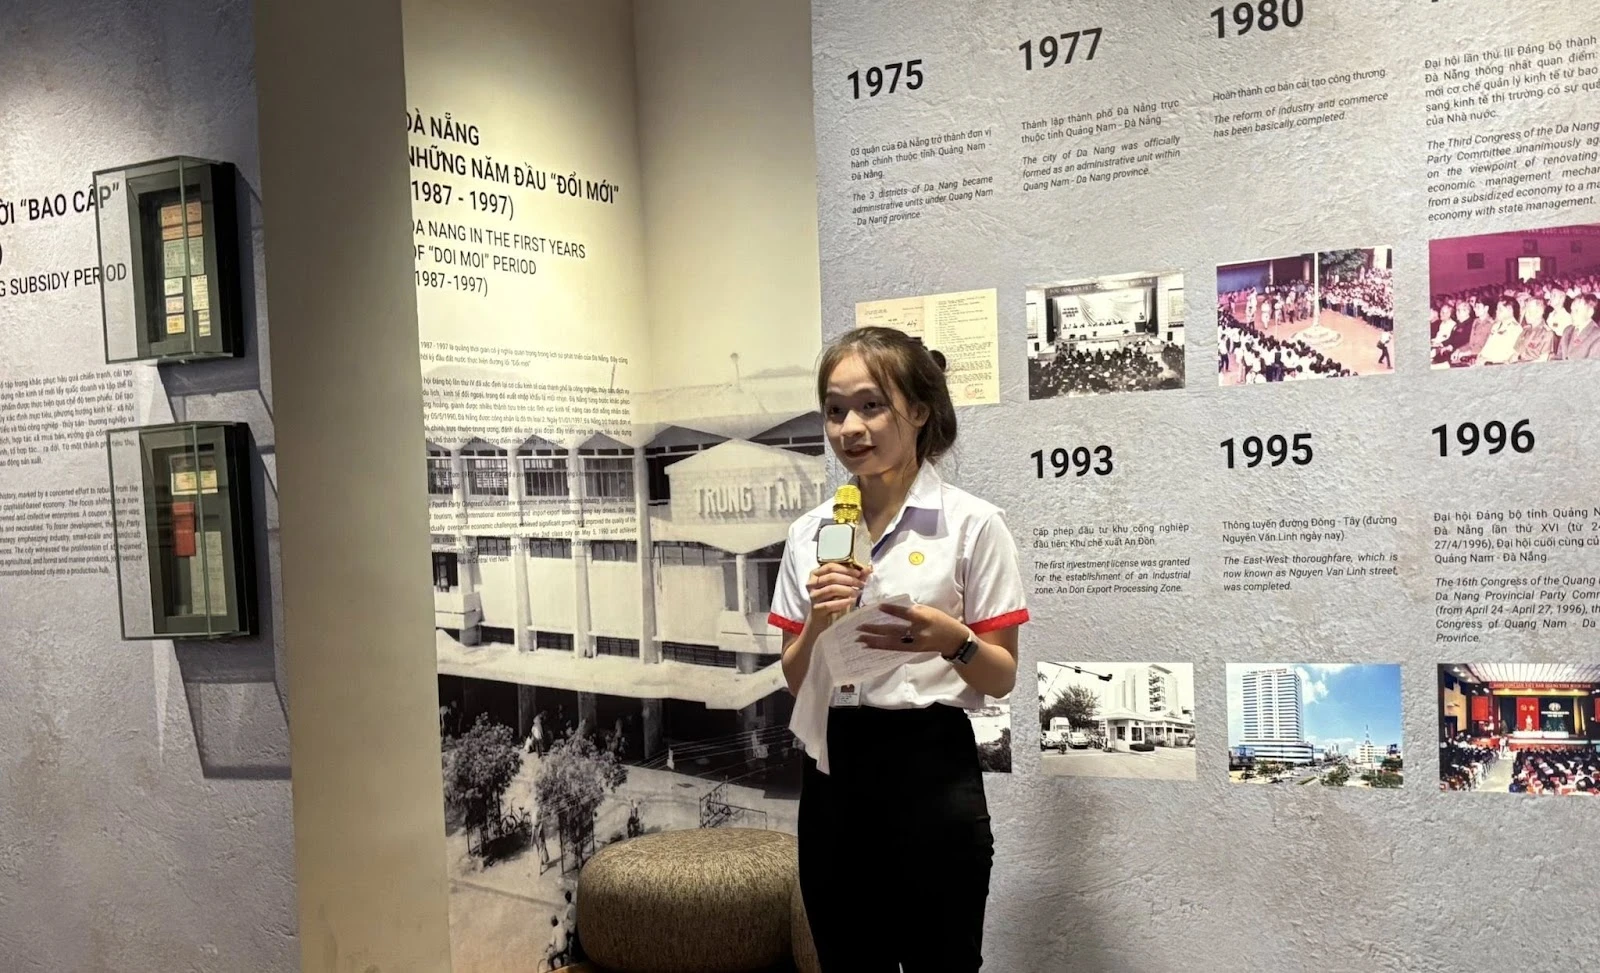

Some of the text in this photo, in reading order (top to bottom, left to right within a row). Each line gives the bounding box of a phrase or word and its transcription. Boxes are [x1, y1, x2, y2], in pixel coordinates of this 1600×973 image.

[1210, 0, 1303, 38] 1980
[1019, 28, 1102, 70] 1977
[848, 59, 923, 99] 1975
[1214, 93, 1388, 124] The reform of industry and commerce
[430, 112, 479, 146] NẴNG
[1214, 119, 1294, 137] has been basically
[1427, 122, 1599, 150] The Third Congress of the Da Nang
[1023, 135, 1180, 165] The city of Da Nang was officially
[1427, 138, 1581, 164] Party Committee unanimously
[409, 145, 466, 175] NHỮNG
[472, 156, 509, 184] NĂM
[514, 162, 546, 191] ĐẦU
[1023, 167, 1050, 177] formed
[1065, 164, 1074, 172] an
[1077, 154, 1135, 170] administrative
[1137, 154, 1153, 162] unit
[1155, 150, 1180, 159] within
[1447, 166, 1462, 176] the
[1470, 160, 1517, 173] viewpoint
[1525, 157, 1536, 167] of
[1543, 151, 1597, 165] renovating
[879, 188, 907, 198] districts
[912, 185, 920, 194] of
[924, 183, 934, 191] Da
[938, 181, 958, 190] Nang
[963, 176, 993, 186] became
[1023, 167, 1150, 191] Quang Nam Da Nang province.
[1428, 172, 1551, 193] economic management
[412, 181, 514, 221] 1987 1997)
[1428, 183, 1575, 207] from subsidized economy to
[0, 198, 14, 225] ỜI
[1428, 196, 1596, 222] economy with state management.
[412, 219, 585, 259] A NANG IN THE FIRST YEARS
[415, 246, 425, 261] F
[494, 256, 536, 275] PERIOD
[0, 280, 5, 296] G
[11, 271, 70, 294] SUBSIDY
[416, 271, 488, 297] 1987-1997)
[1432, 419, 1535, 456] 1996
[1031, 445, 1113, 479] 1993
[1220, 433, 1313, 469] 1995
[694, 485, 754, 517] TRUNG
[764, 472, 802, 516] TÂM
[1224, 556, 1239, 564] The
[1243, 555, 1288, 564] East-West
[1292, 554, 1353, 565] thoroughfare,
[1358, 553, 1385, 561] which
[1035, 573, 1045, 581] for
[1066, 572, 1120, 581] establishment
[1125, 571, 1134, 579] of
[1244, 569, 1272, 577] known
[1289, 568, 1323, 579] Nguyen
[1347, 566, 1366, 575] Linh
[1436, 576, 1595, 588] The 16th Congress of the Quang
[1070, 585, 1084, 593] Don
[1087, 585, 1112, 594] Export
[1114, 583, 1158, 594] Processing
[1160, 583, 1182, 592] Zone.
[1224, 582, 1292, 592] was completed.
[1435, 591, 1566, 602] Da Nang Provincial Party
[1436, 604, 1588, 616] (from April 24 April 27, 1996),
[1436, 618, 1596, 630] Congress of Quang Nam Da
[1436, 633, 1480, 642] Province.
